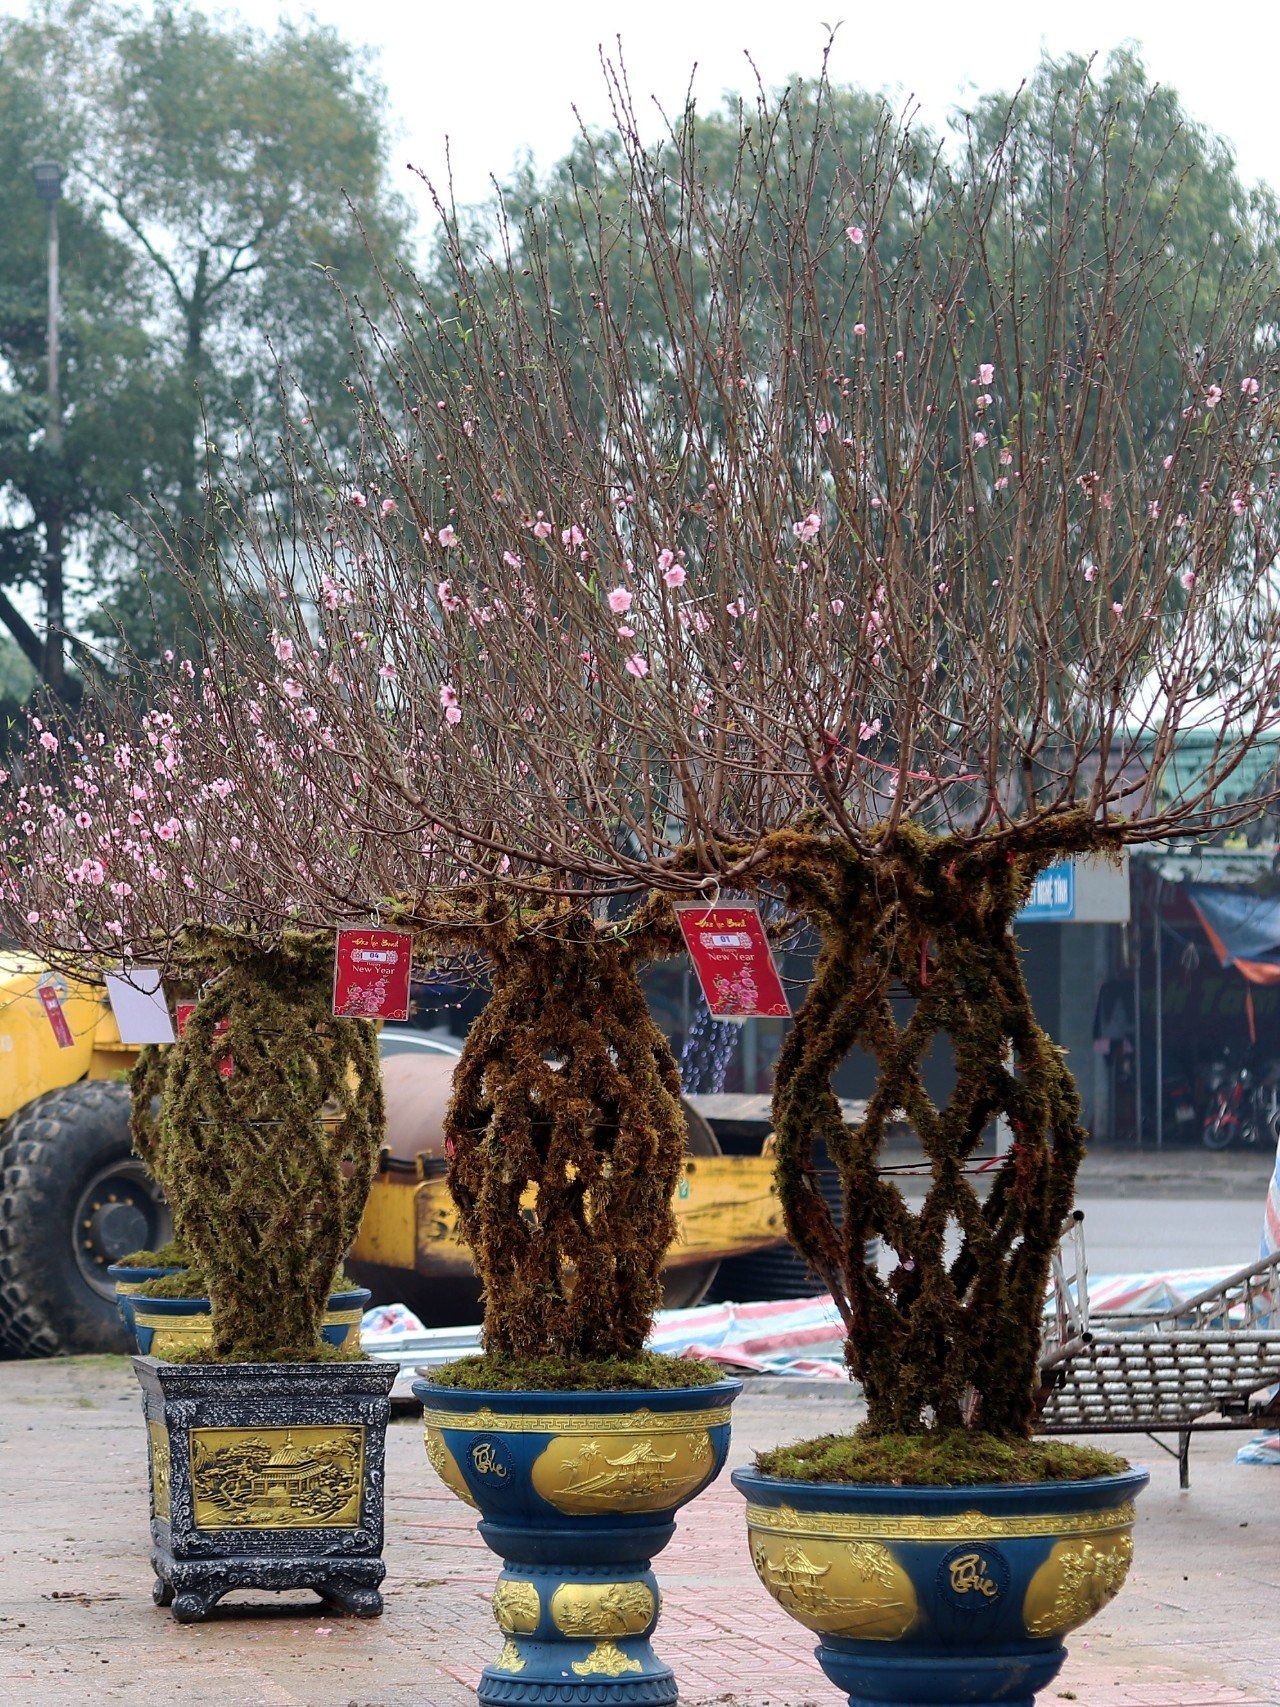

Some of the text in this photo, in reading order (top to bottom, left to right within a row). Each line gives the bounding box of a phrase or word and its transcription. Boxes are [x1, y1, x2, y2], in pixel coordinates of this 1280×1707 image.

[707, 952, 755, 961] New Year
[352, 965, 395, 975] New Year
